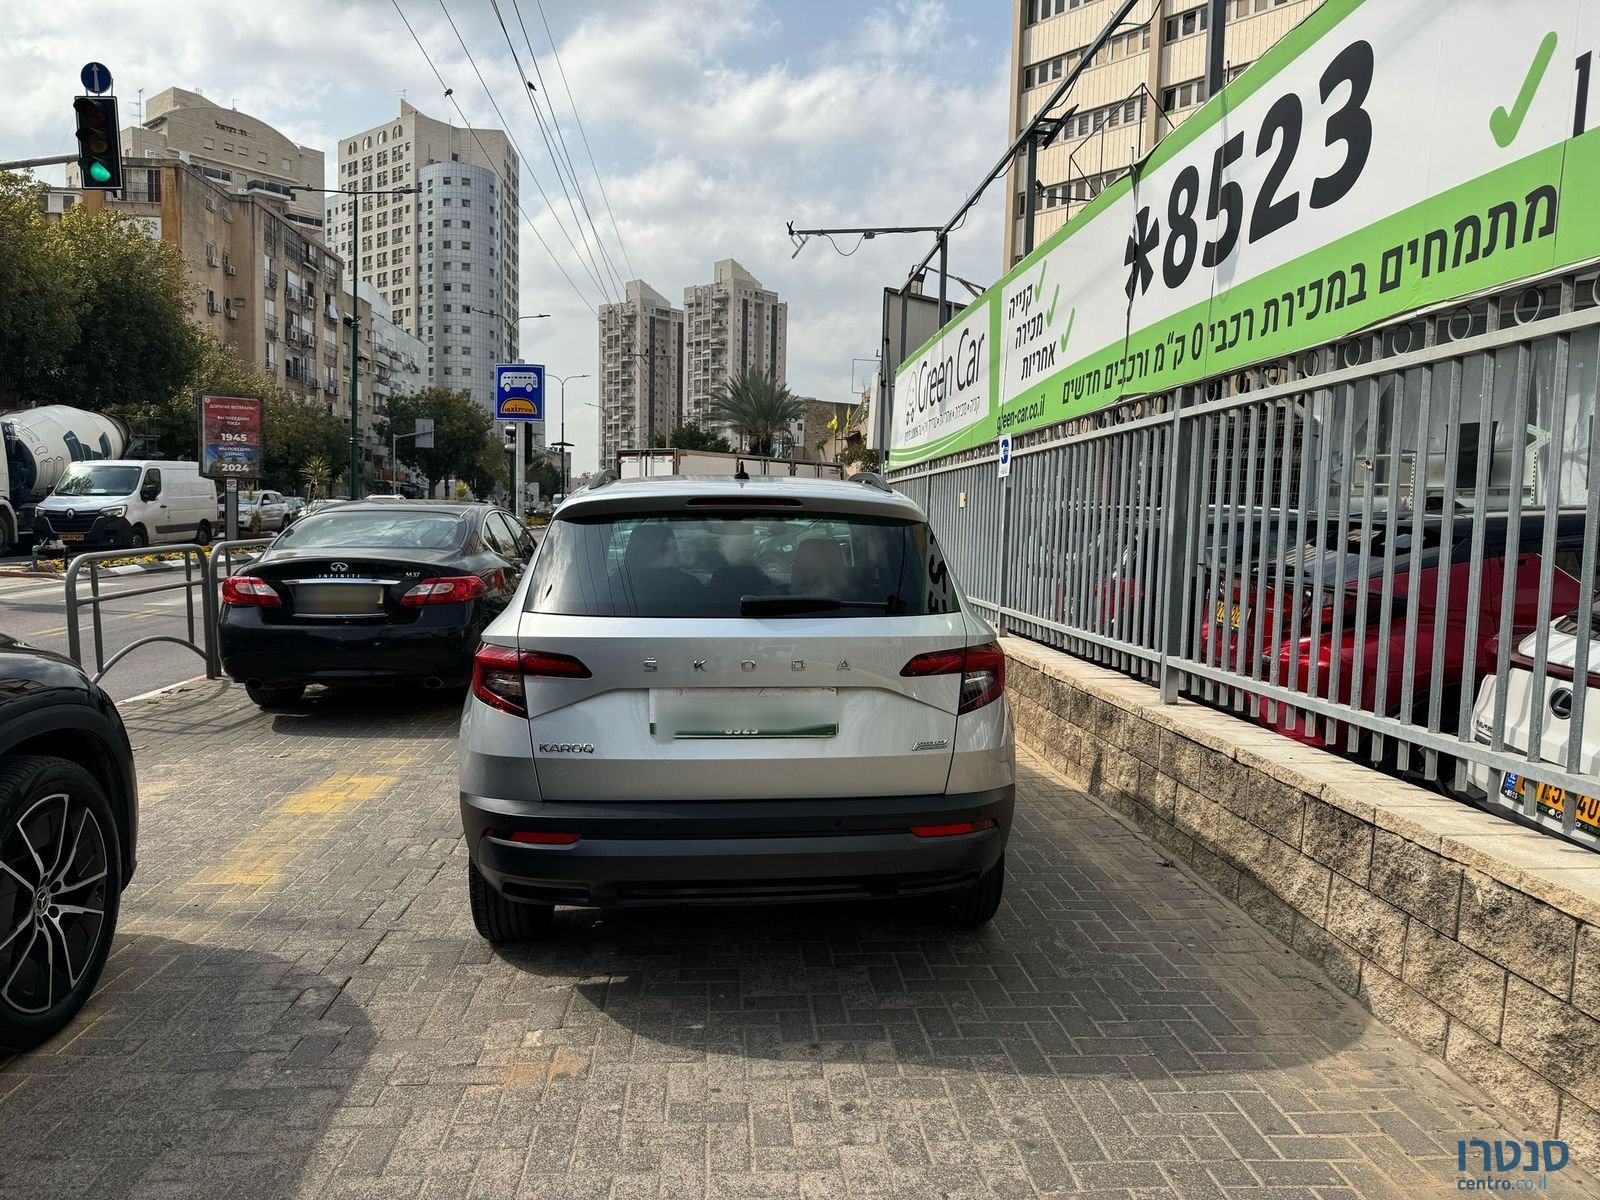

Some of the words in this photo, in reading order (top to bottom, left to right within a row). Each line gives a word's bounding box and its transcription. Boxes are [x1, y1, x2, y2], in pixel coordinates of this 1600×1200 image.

[1379, 184, 1558, 295] מתמחים
[1008, 283, 1034, 320] קנייה
[1260, 262, 1367, 337] במכירת
[1015, 312, 1044, 350] מכירה
[1191, 322, 1204, 361] 0
[1209, 308, 1255, 354] רכבי
[918, 355, 953, 413] Green
[956, 328, 985, 391] Car
[1021, 340, 1057, 381] אחריות
[1104, 348, 1150, 390] ורכבים
[1153, 330, 1186, 374] ק"מ
[1062, 368, 1101, 405] חדשים
[220, 433, 247, 442] 1945
[221, 463, 249, 472] 2024
[539, 743, 595, 754] KAROQ
